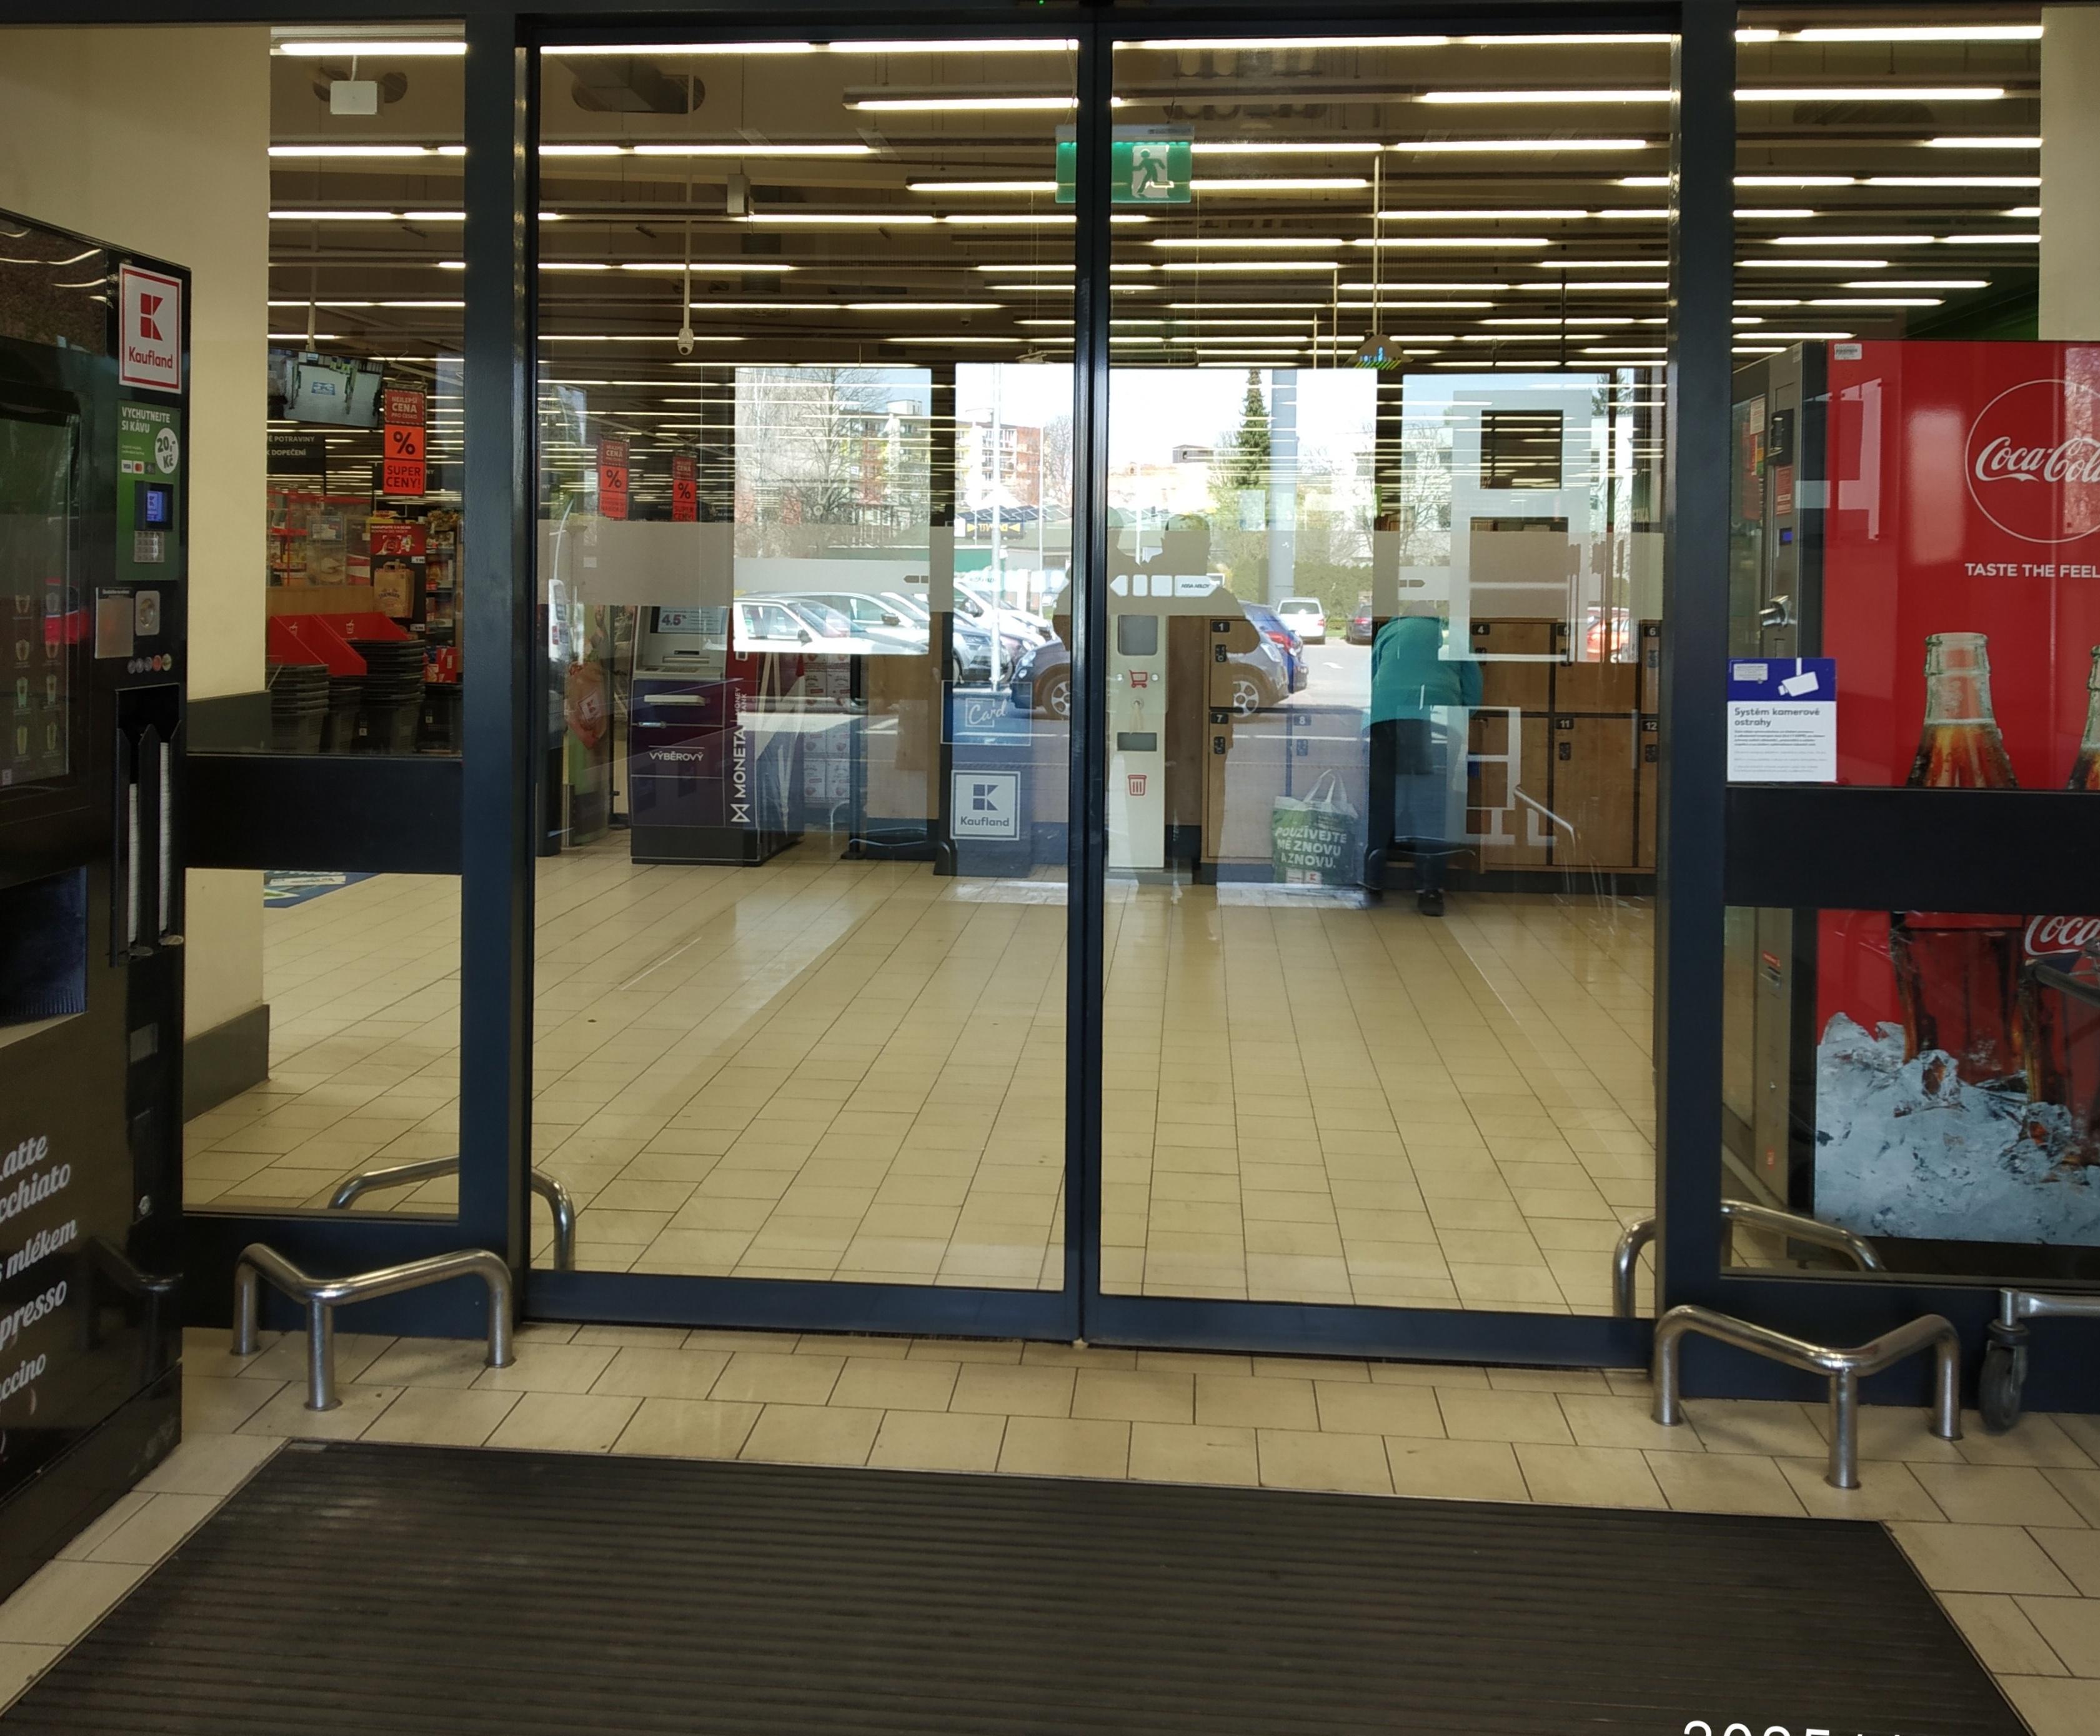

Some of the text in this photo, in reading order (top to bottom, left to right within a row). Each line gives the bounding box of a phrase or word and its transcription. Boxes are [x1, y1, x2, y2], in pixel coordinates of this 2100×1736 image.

[129, 346, 173, 369] Kaufland
[392, 402, 417, 413] CENA
[122, 406, 171, 423] VYCHUTNEJTE
[122, 419, 150, 433] SI KÁVU
[606, 449, 623, 457] CENA
[163, 454, 174, 469] Kč
[387, 465, 421, 476] SUPER
[386, 477, 422, 489] CENY!
[1964, 563, 2018, 577] TASTE
[2022, 564, 2056, 577] THE
[1478, 626, 1484, 634] 4
[1649, 627, 1656, 636] 6
[969, 699, 1007, 725] Card
[1734, 707, 1820, 717] Systém kamerové
[1217, 714, 1223, 722] 7
[1299, 716, 1305, 724] 8
[1734, 719, 1771, 727] ostrahy
[1560, 720, 1570, 728] 11
[1645, 722, 1658, 730] 12
[650, 751, 704, 761] VÝBĚROVÝ
[733, 726, 746, 798] MONETA
[960, 816, 1010, 827] Kaufland
[1293, 841, 1341, 856] ZNOVU
[1281, 852, 1336, 868] A ZNOVU.
[0, 1135, 48, 1181] atte
[6, 1219, 77, 1279] mlékem
